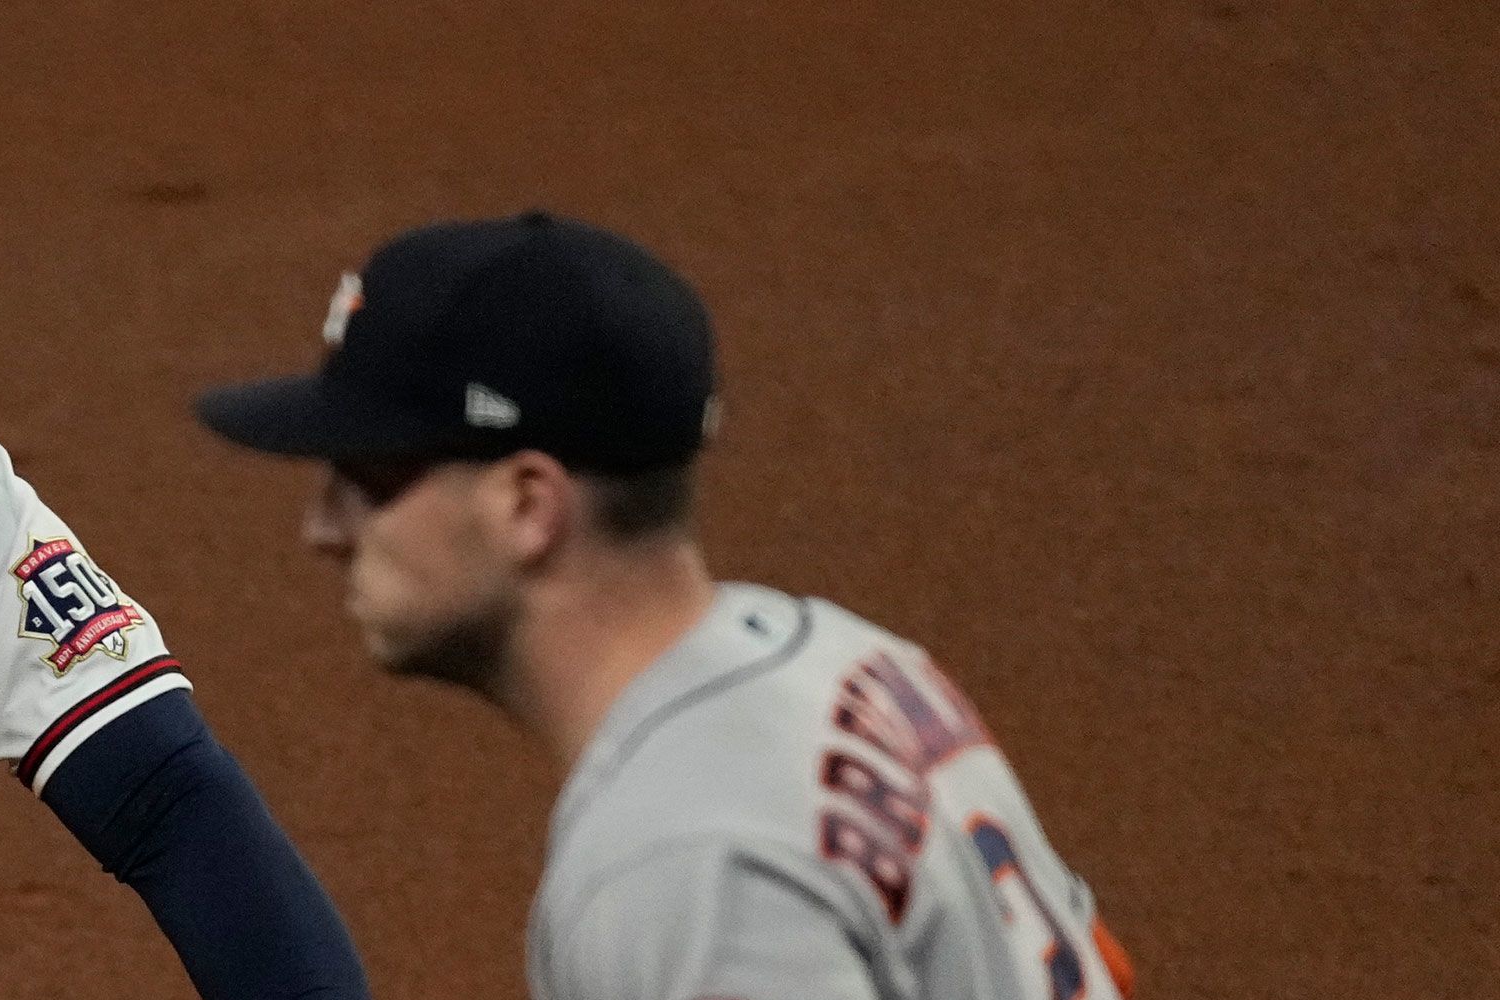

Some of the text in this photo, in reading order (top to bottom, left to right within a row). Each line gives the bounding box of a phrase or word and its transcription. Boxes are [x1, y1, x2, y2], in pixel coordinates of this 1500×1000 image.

[20, 542, 68, 574] BRAVES
[22, 552, 117, 642] 150
[75, 612, 127, 650] ANNIVERSARY
